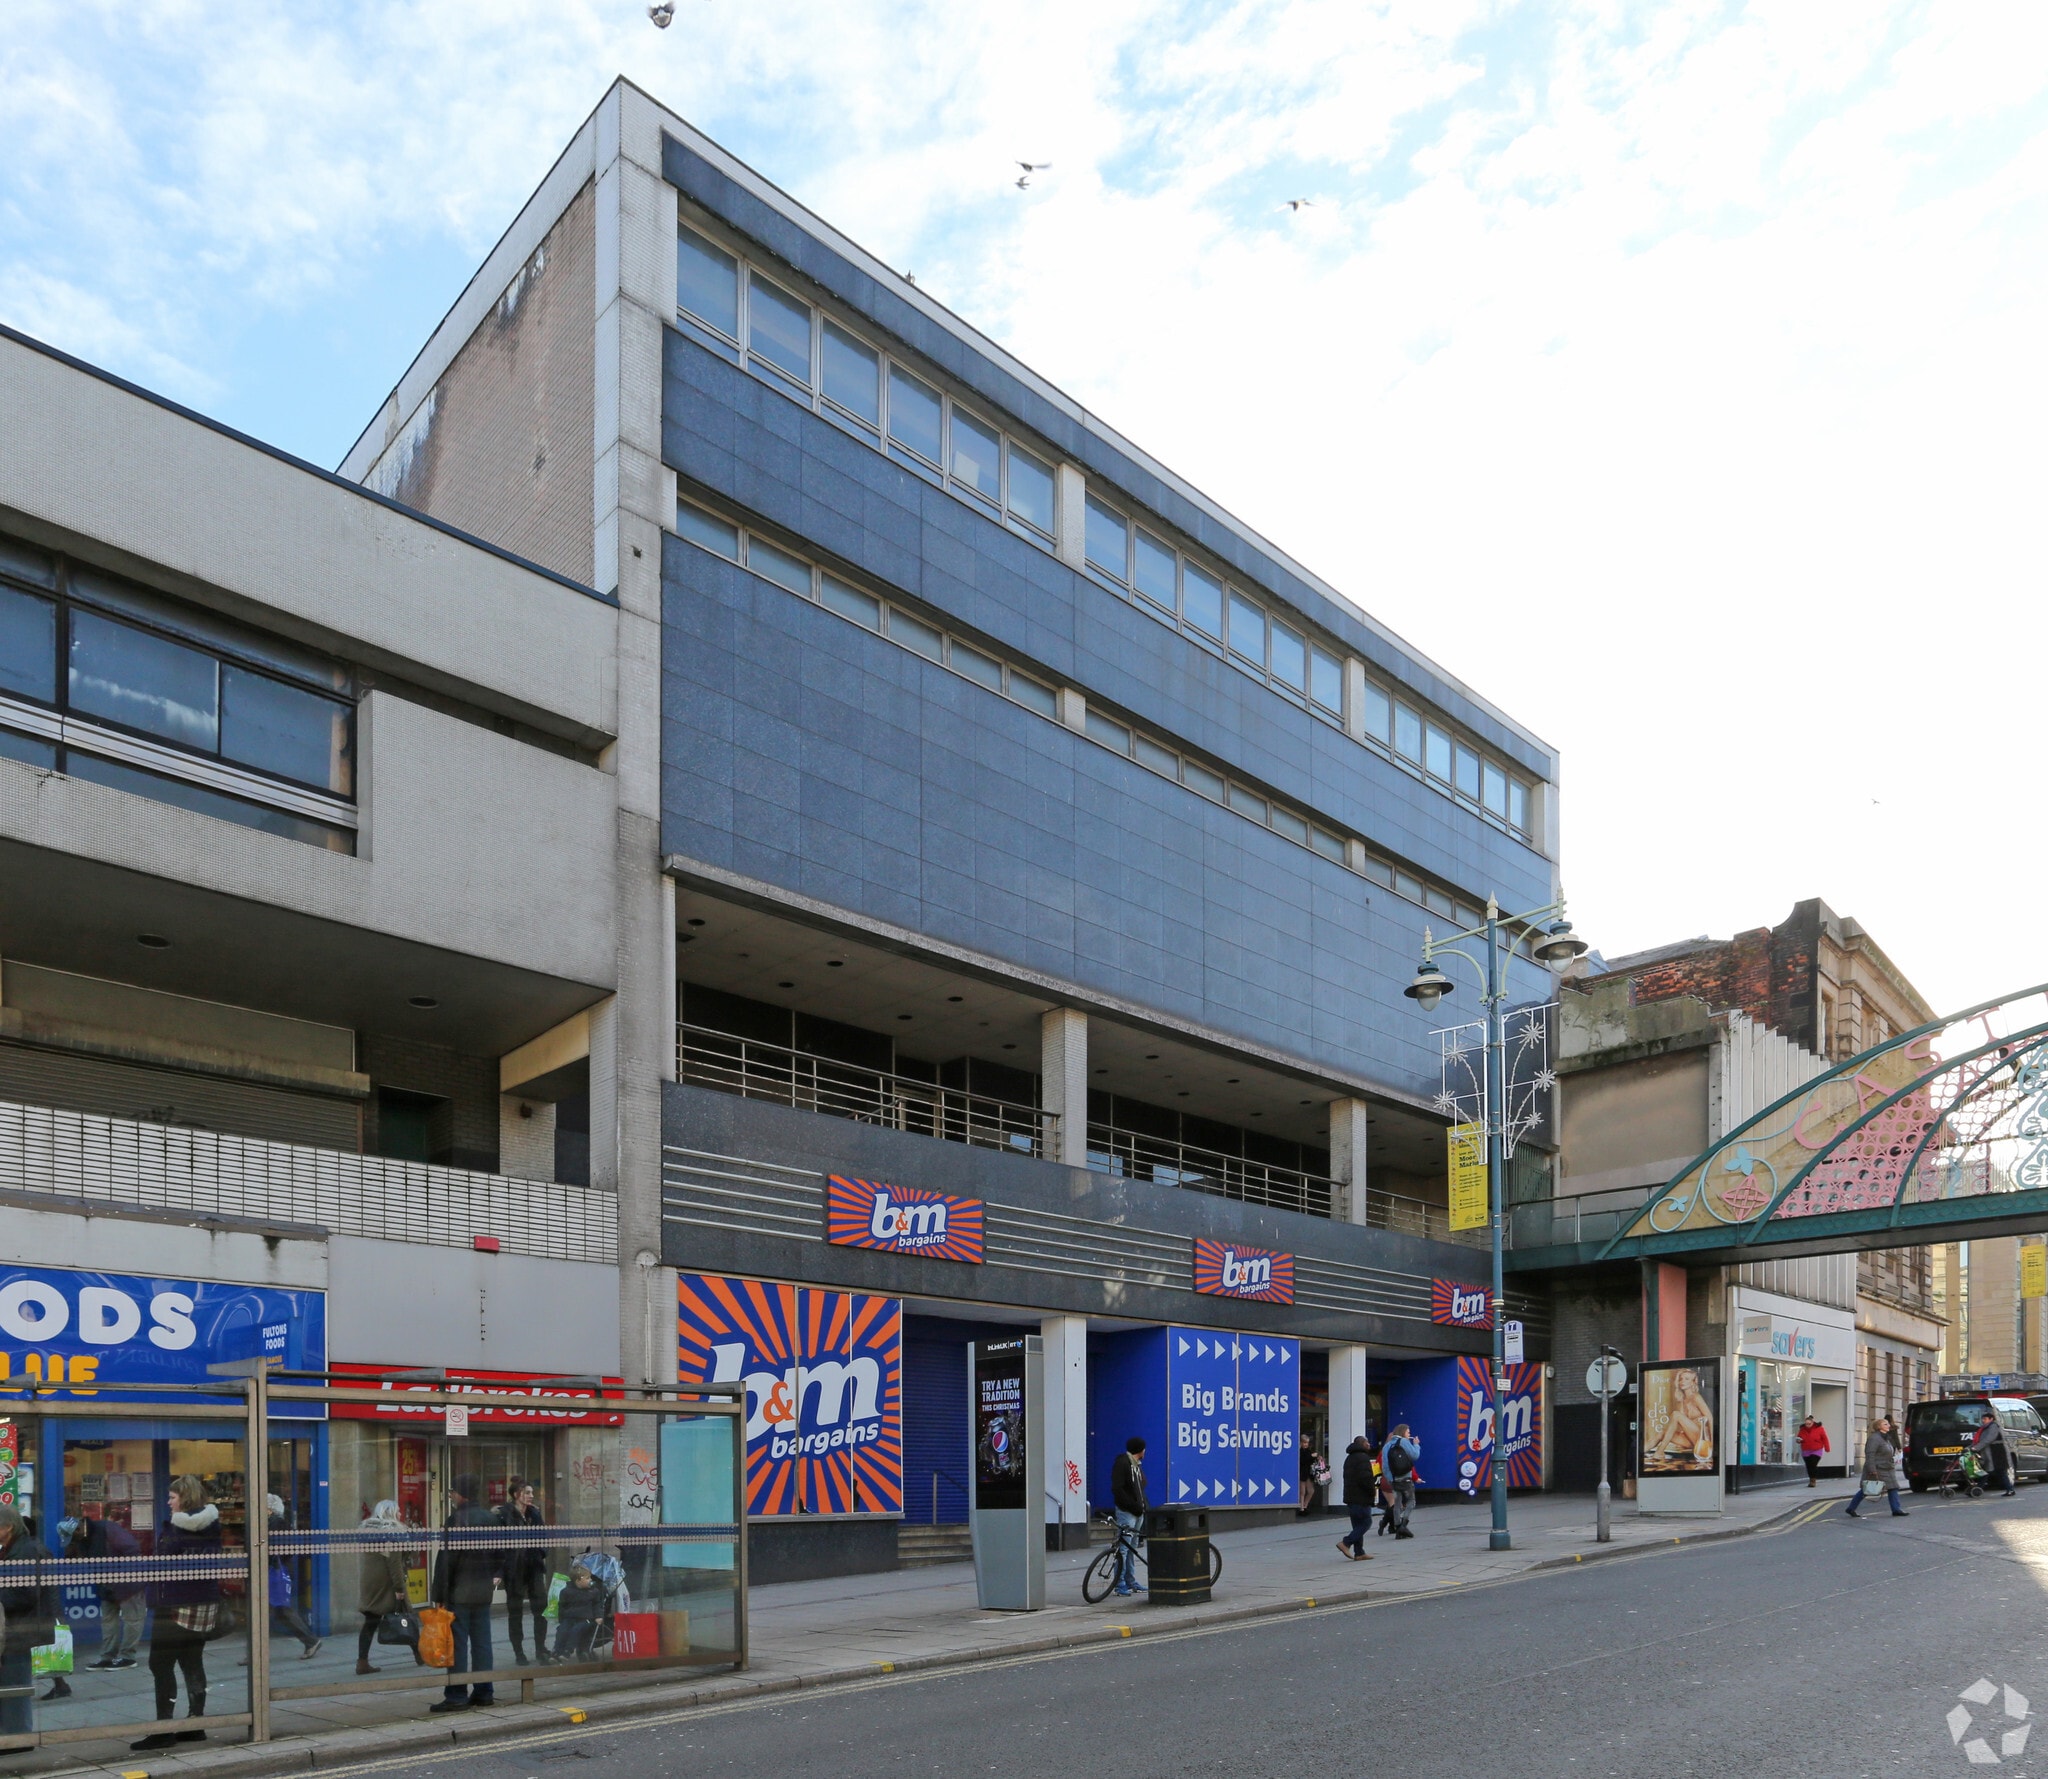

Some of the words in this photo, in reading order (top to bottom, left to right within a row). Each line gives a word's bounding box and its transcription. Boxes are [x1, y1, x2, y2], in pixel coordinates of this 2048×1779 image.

[871, 1193, 948, 1239] b&m
[899, 1233, 946, 1247] bargains
[1222, 1251, 1271, 1287] b&m
[1239, 1281, 1271, 1293] bargains
[262, 1323, 287, 1338] FULTONS
[265, 1336, 285, 1350] FOODS
[1771, 1326, 1816, 1359] savers
[982, 1380, 996, 1391] TRY
[996, 1379, 1002, 1390] A
[1003, 1378, 1020, 1390] NEW
[982, 1389, 1020, 1402] TRADITION
[1182, 1383, 1215, 1416] Big
[1222, 1386, 1289, 1413] Brands
[993, 1402, 1020, 1411] CHRISTMAS
[771, 1423, 879, 1459] bargains
[1178, 1421, 1211, 1454] Big
[1218, 1423, 1292, 1455] Savings
[617, 1630, 636, 1654] GAP
